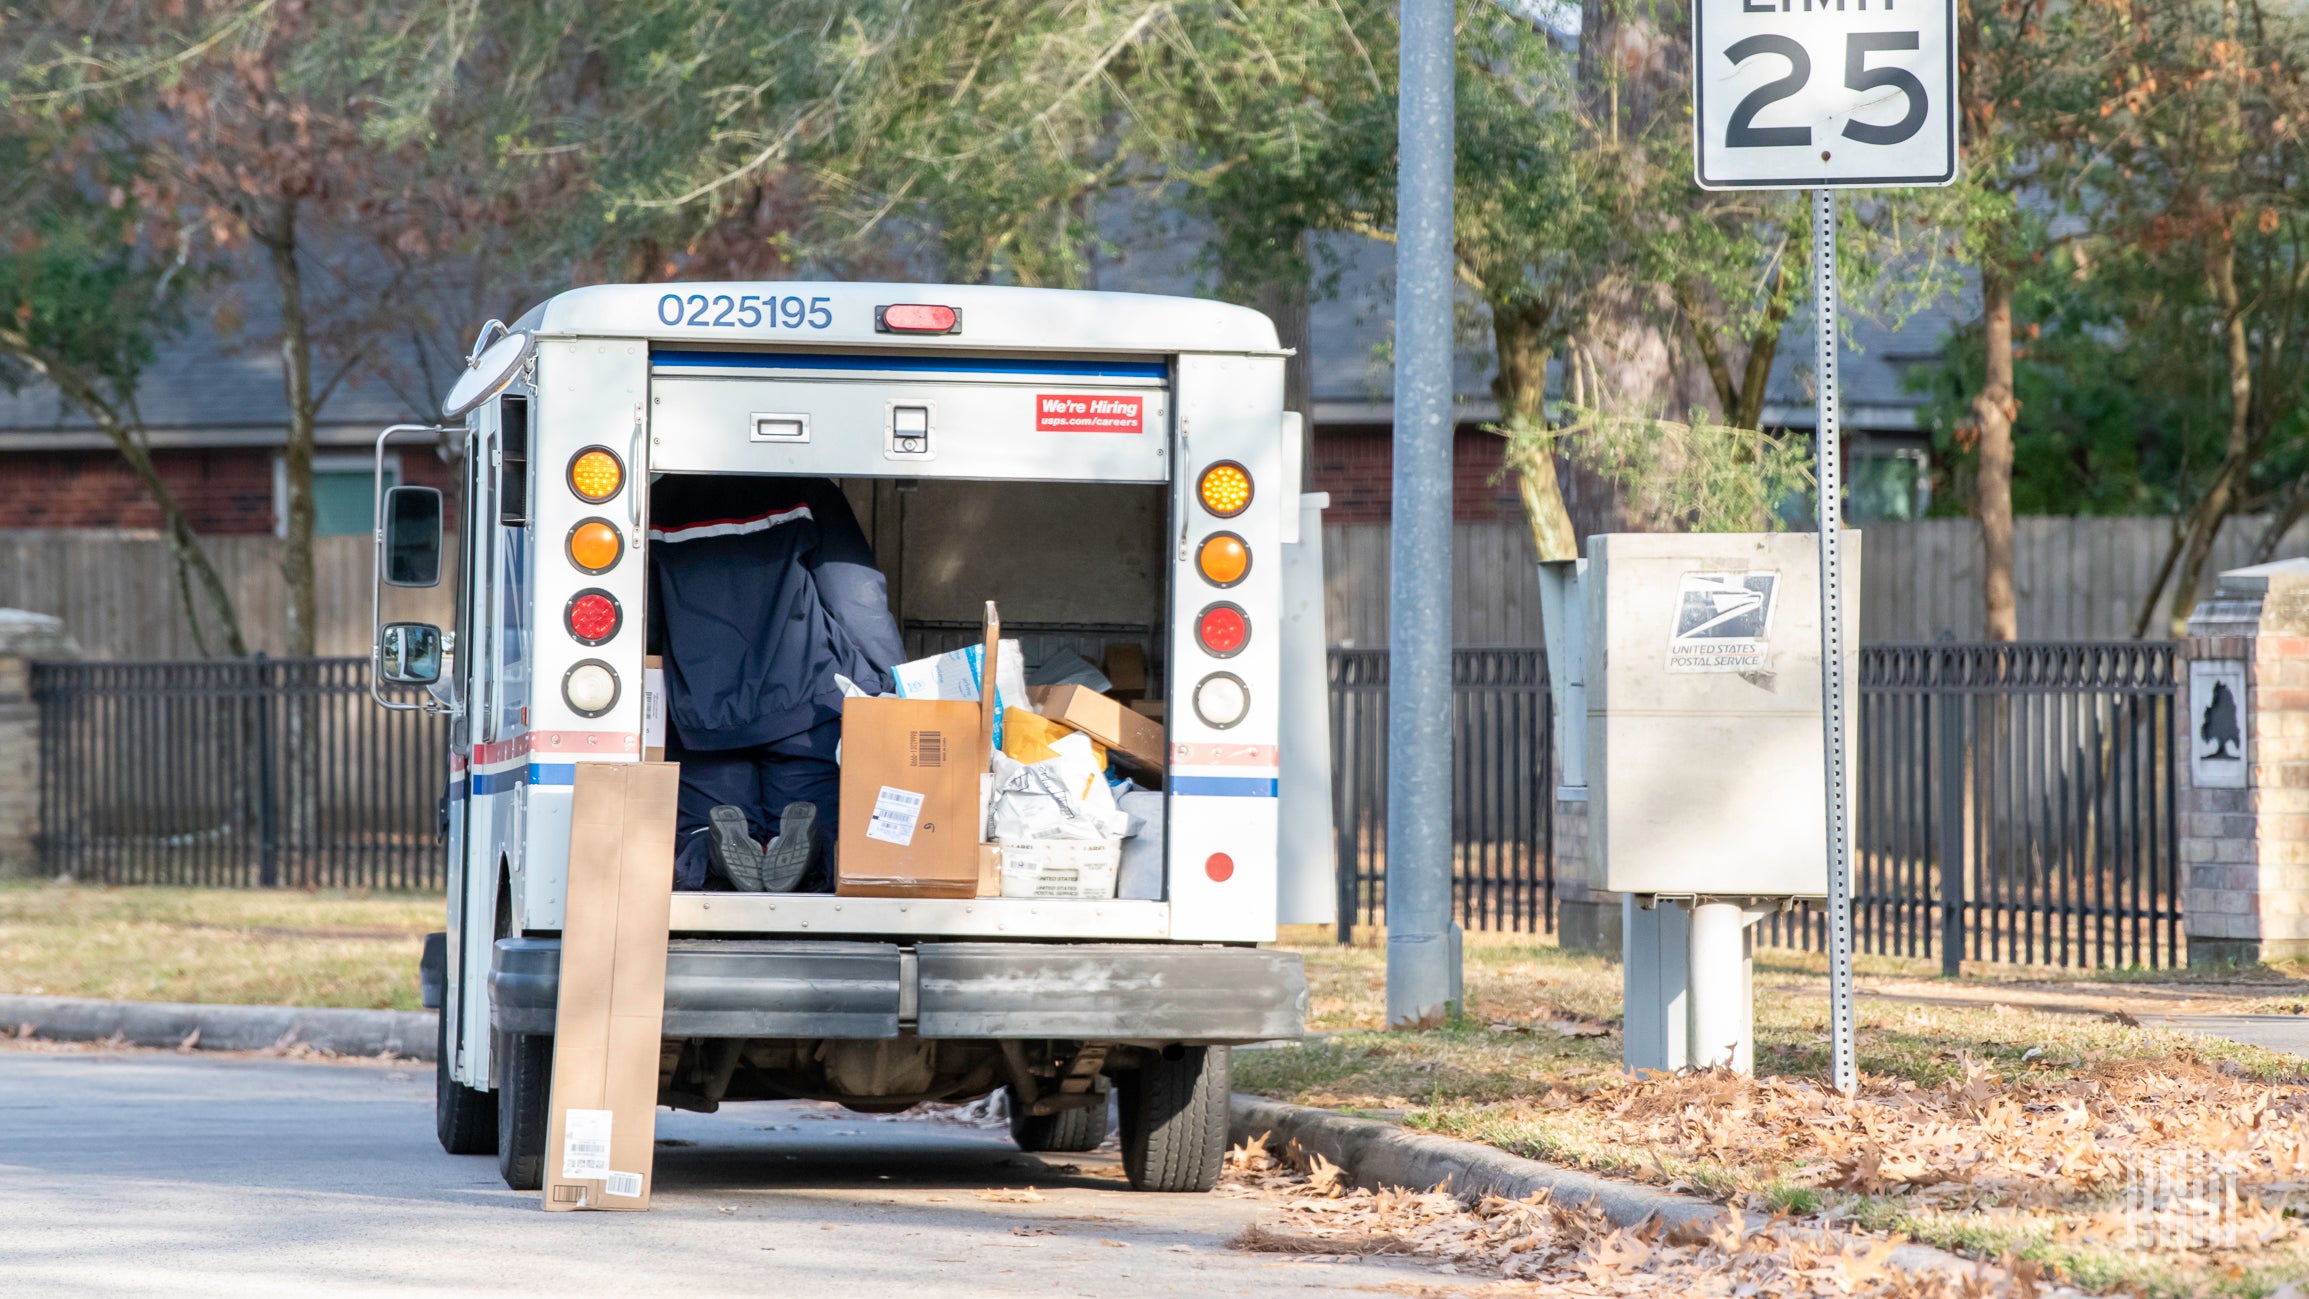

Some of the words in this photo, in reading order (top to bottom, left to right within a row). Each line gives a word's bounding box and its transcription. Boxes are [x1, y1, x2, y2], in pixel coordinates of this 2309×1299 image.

[1723, 30, 1929, 148] 25
[657, 293, 833, 330] 0225195
[1042, 399, 1087, 414] We're
[1089, 400, 1138, 418] Hiring
[1040, 416, 1138, 427] usps.com/careers
[1672, 644, 1715, 654] UNITED
[1717, 643, 1757, 654] STATES
[1670, 656, 1712, 667] POSTAL
[1714, 655, 1760, 666] SERVICE
